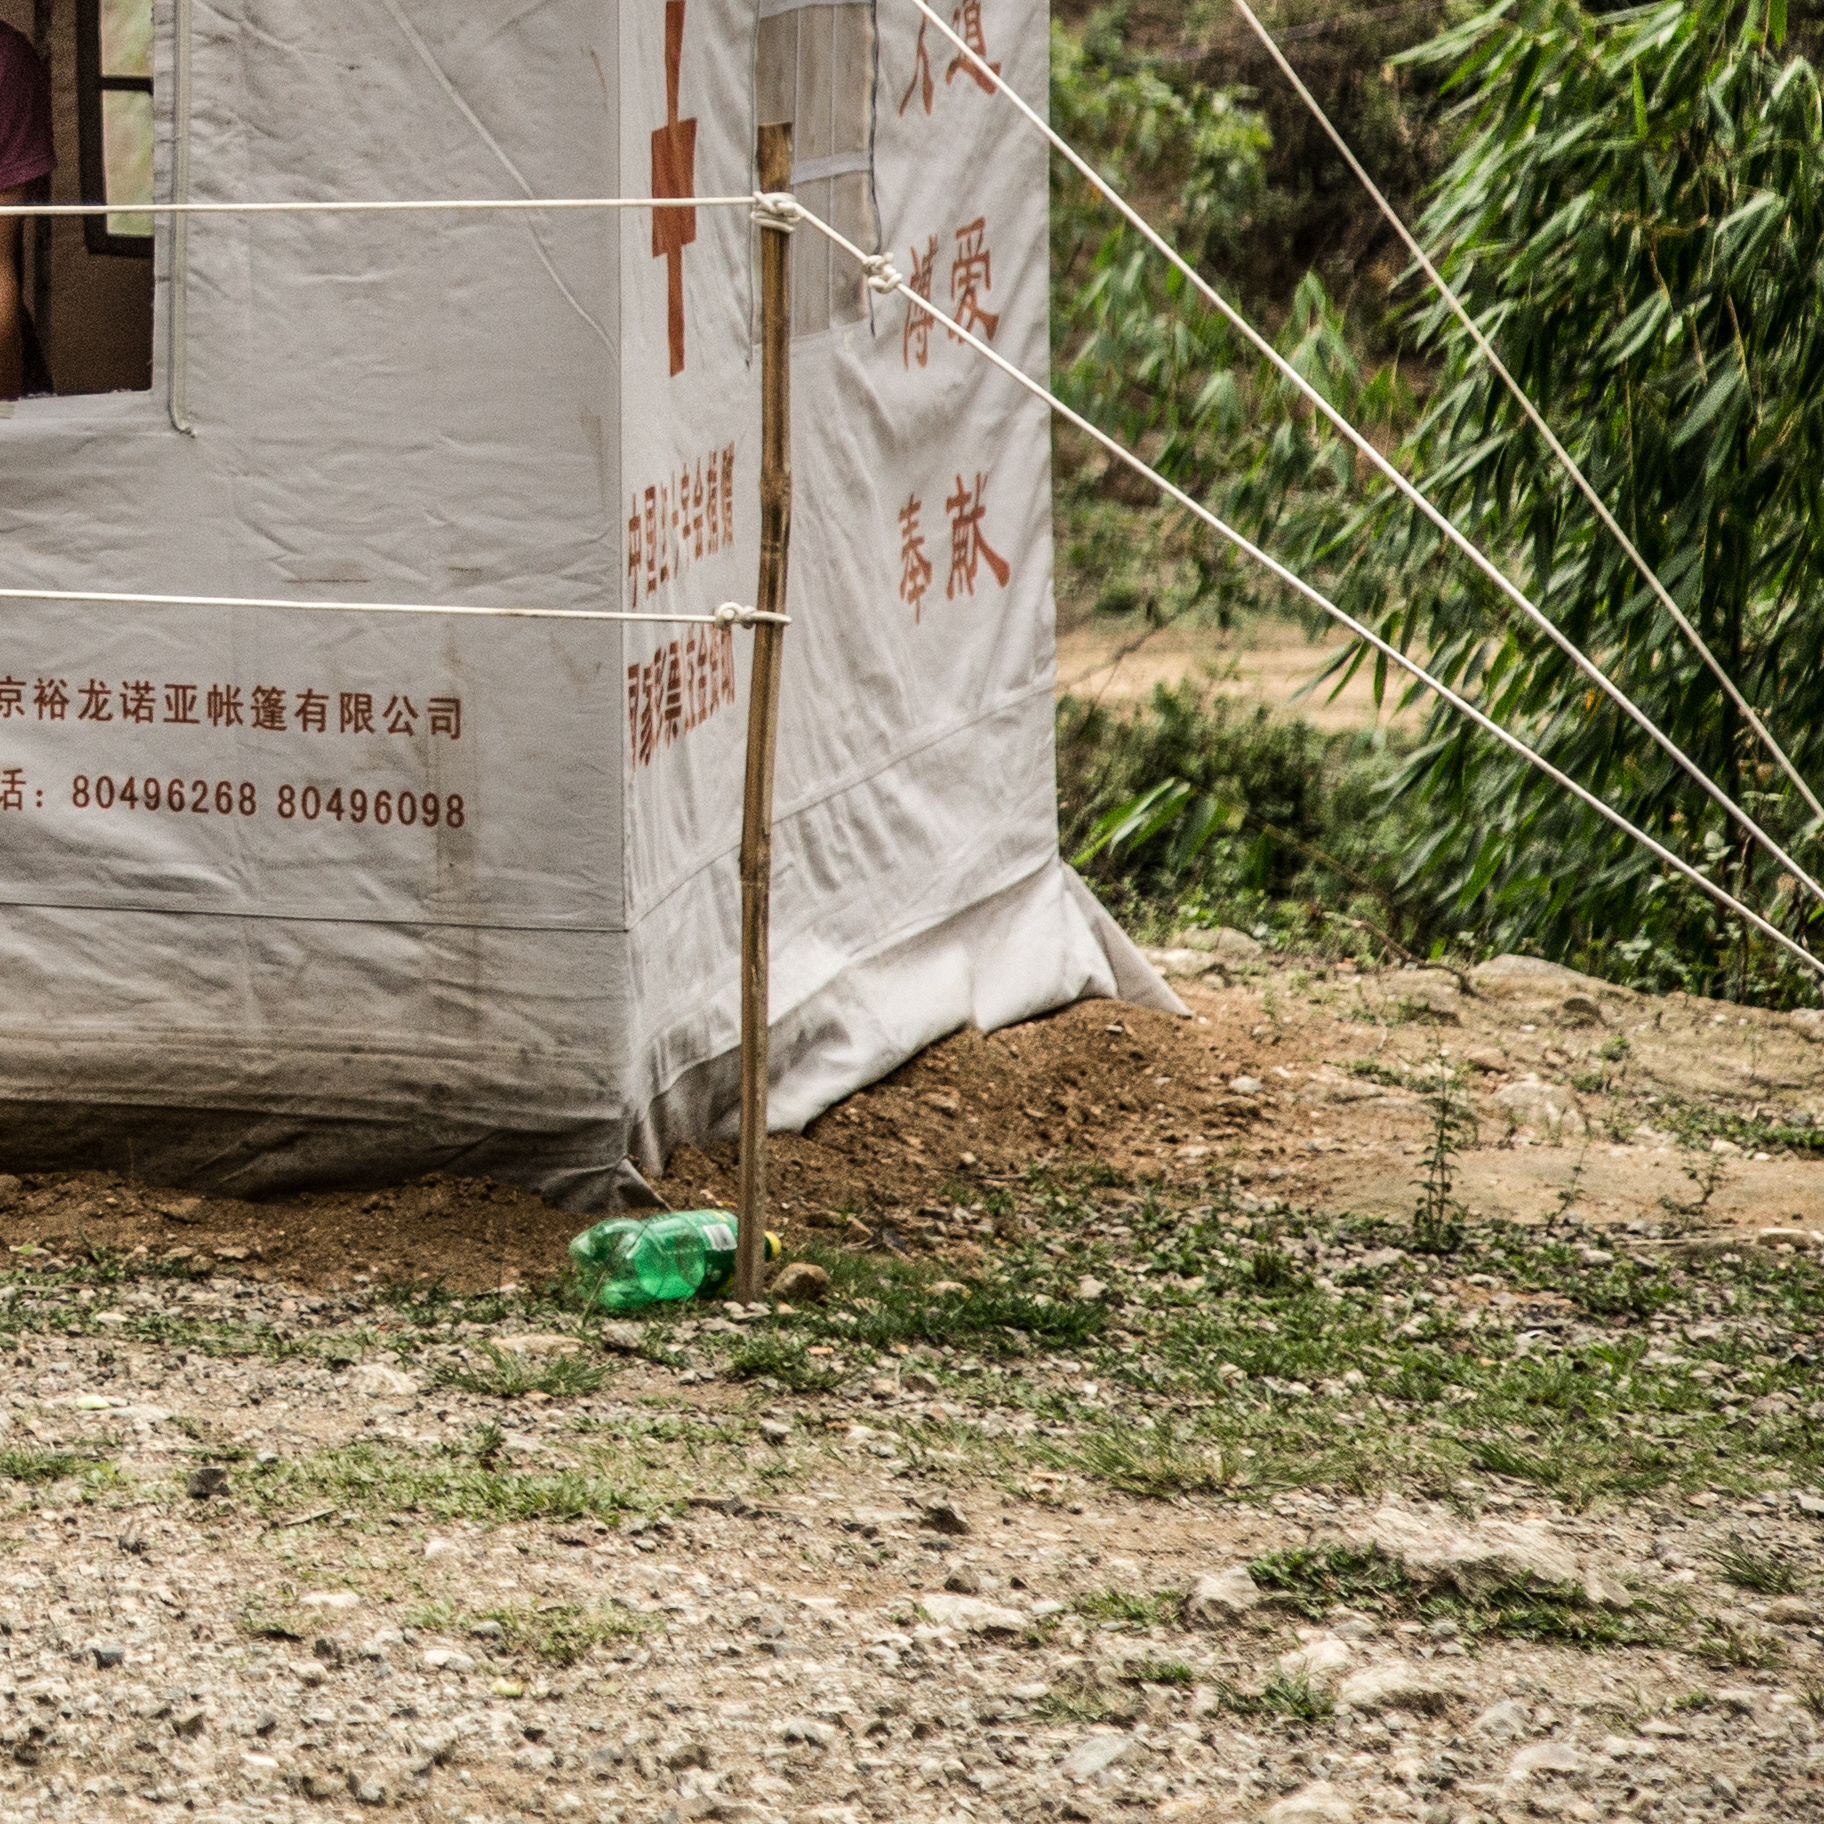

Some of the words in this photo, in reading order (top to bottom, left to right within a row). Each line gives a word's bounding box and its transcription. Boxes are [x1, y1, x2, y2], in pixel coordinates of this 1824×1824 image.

[898, 472, 1011, 625] 奉献
[72, 774, 257, 817] 80496268
[277, 783, 466, 829] 80496098
